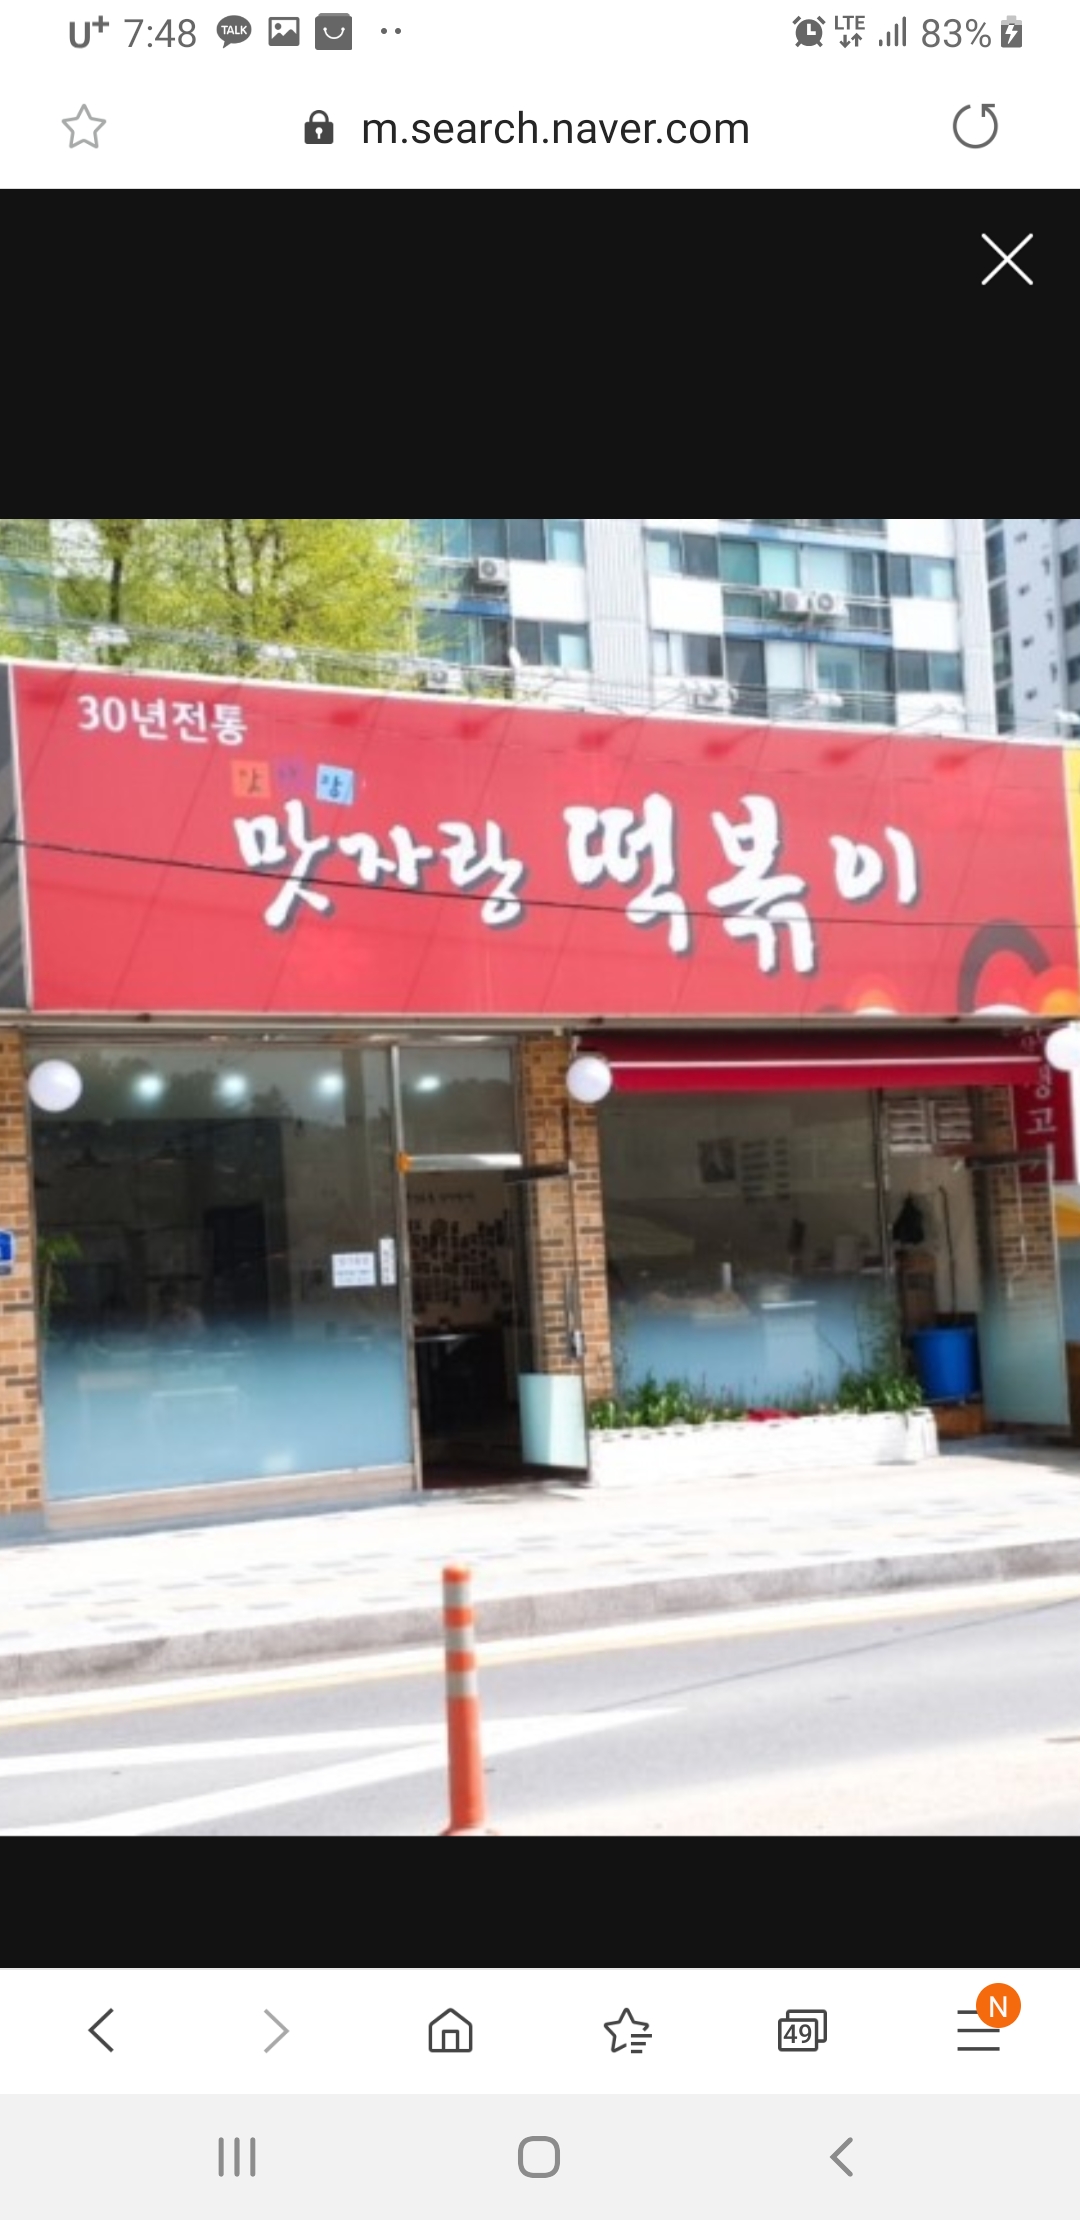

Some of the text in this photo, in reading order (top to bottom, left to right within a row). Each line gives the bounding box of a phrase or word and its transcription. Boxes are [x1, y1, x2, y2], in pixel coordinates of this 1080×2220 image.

[123, 18, 197, 48] 7:48
[220, 24, 248, 36] TALK
[834, 15, 866, 31] LTE
[921, 18, 992, 48] 83%
[363, 110, 749, 145] m.search.naver.com
[233, 792, 920, 976] 맛자랑 떡볶이
[989, 1995, 1008, 2018] N
[783, 2025, 813, 2044] 49
